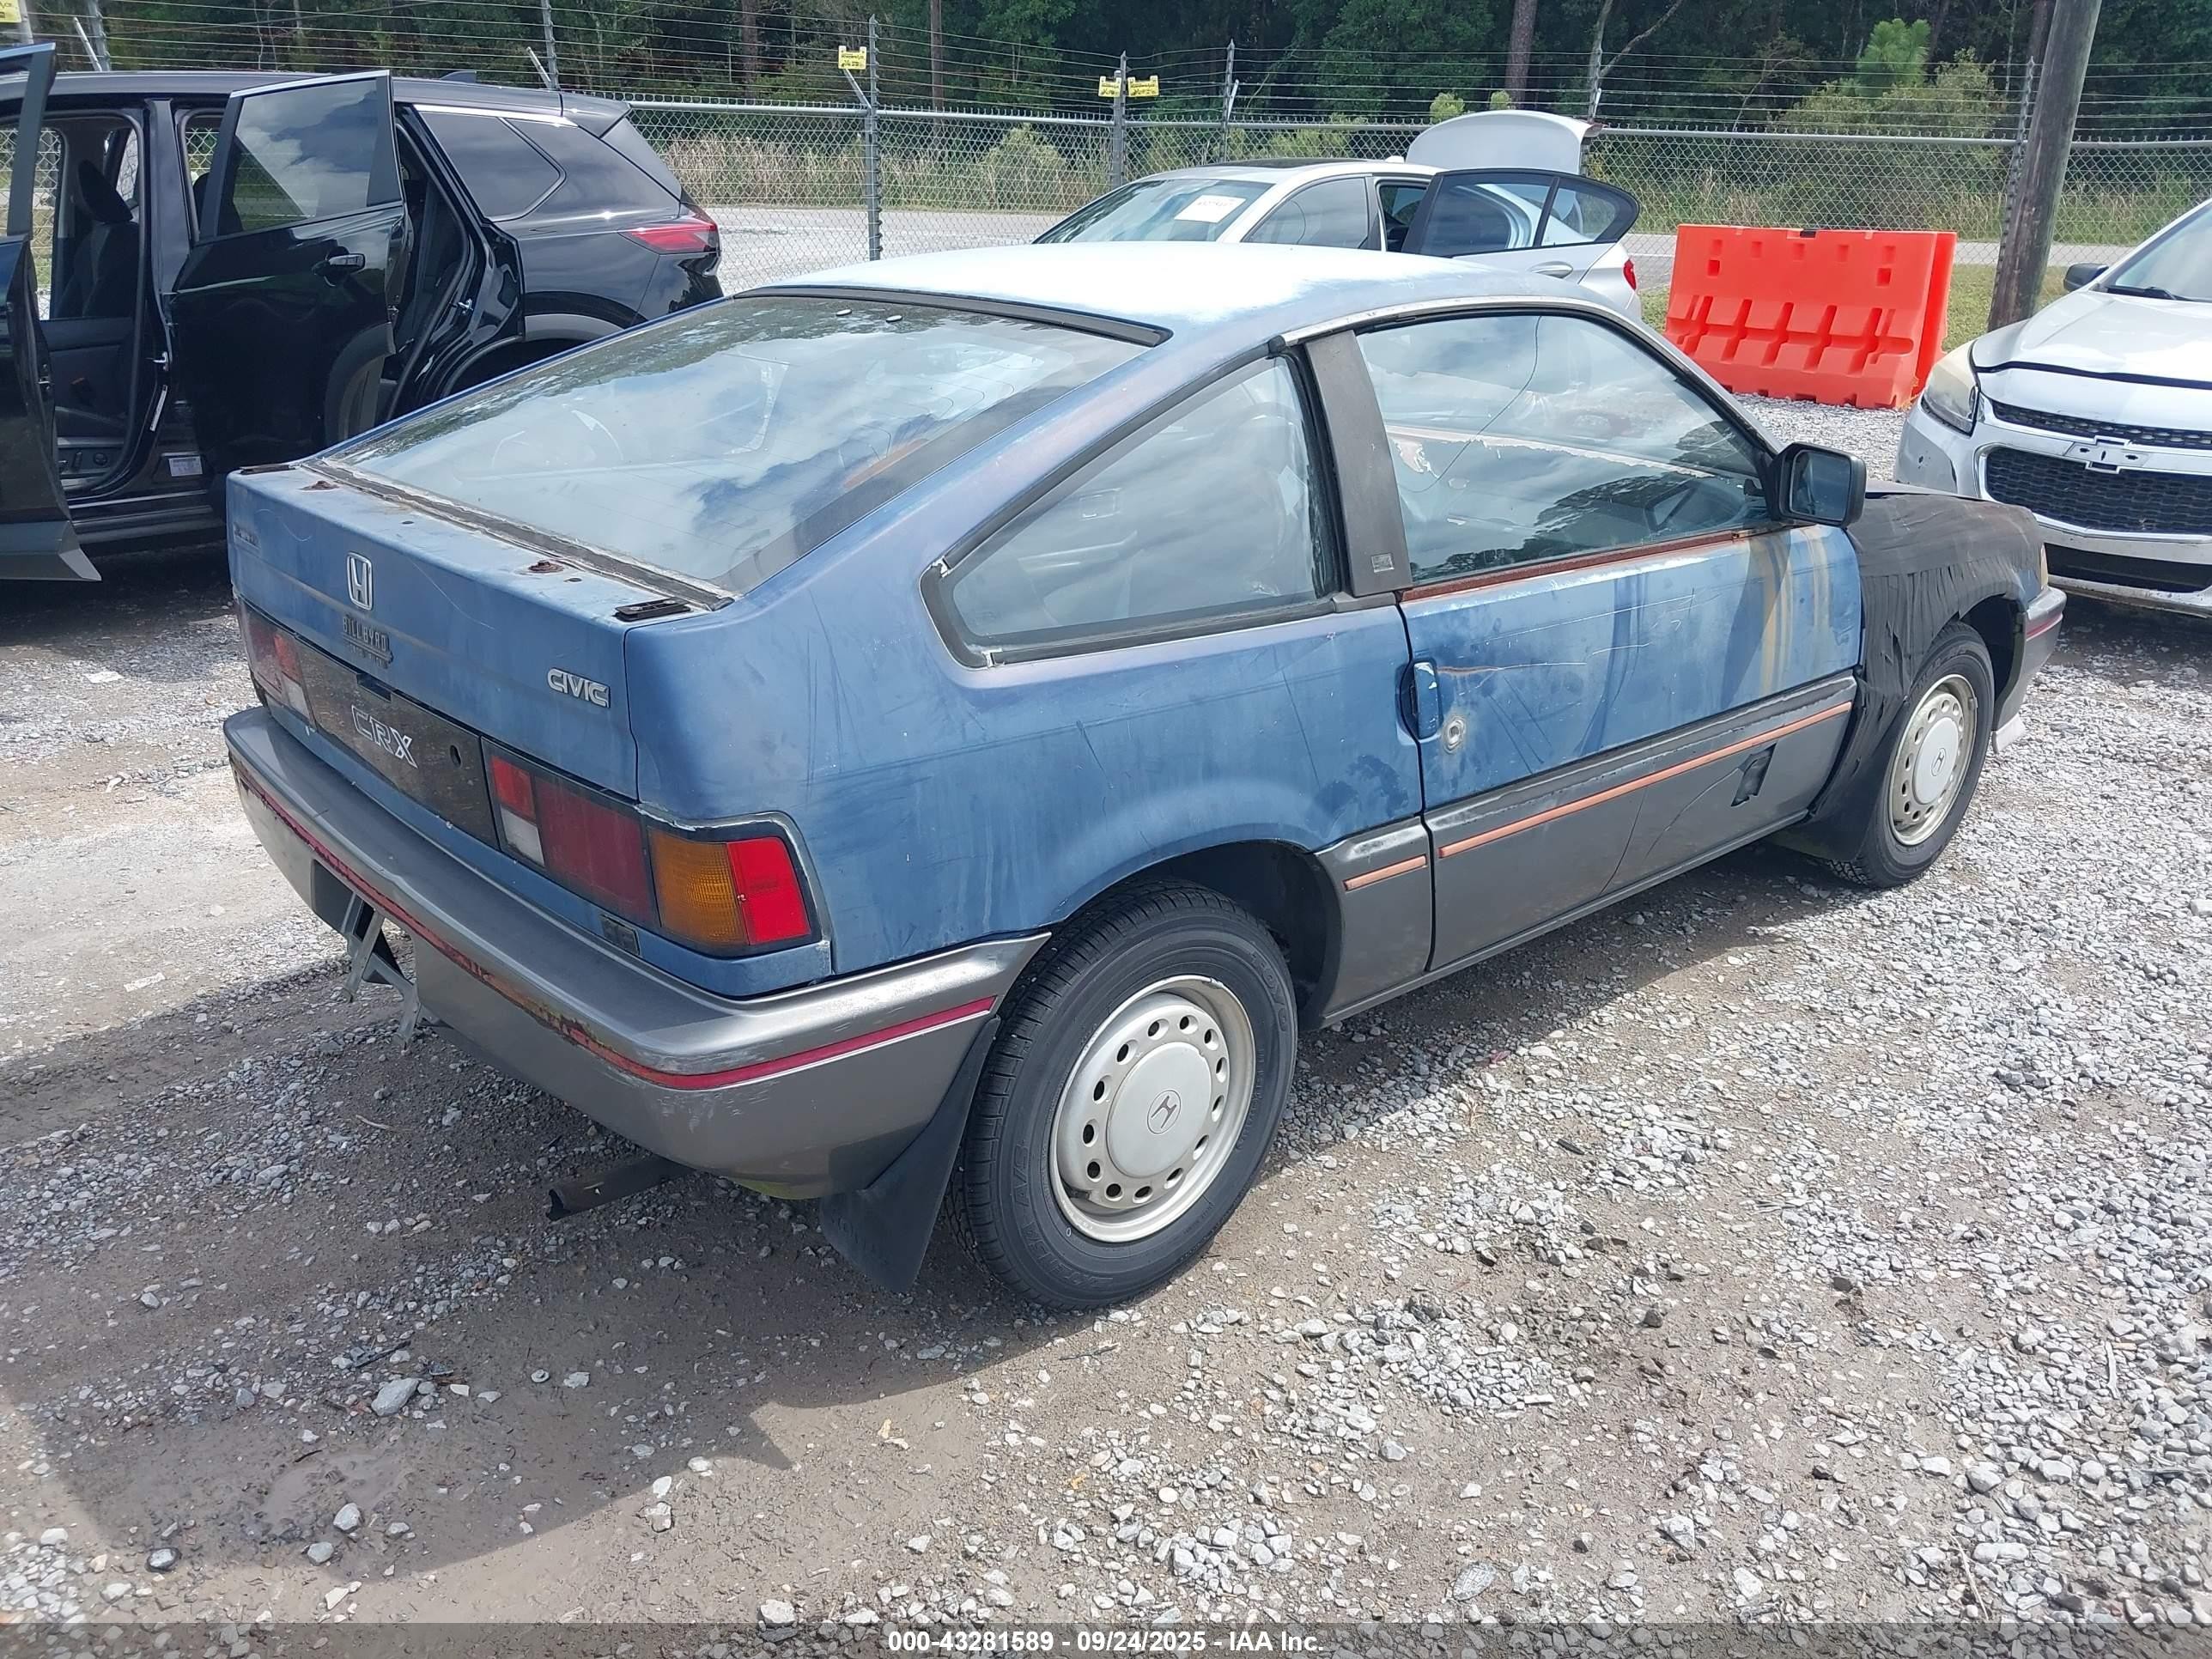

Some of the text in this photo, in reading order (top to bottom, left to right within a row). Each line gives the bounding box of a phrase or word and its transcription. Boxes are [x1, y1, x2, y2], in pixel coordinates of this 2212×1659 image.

[343, 616, 386, 652] BILL BYRD
[548, 668, 610, 708] CIVIC
[350, 704, 418, 769] CRX
